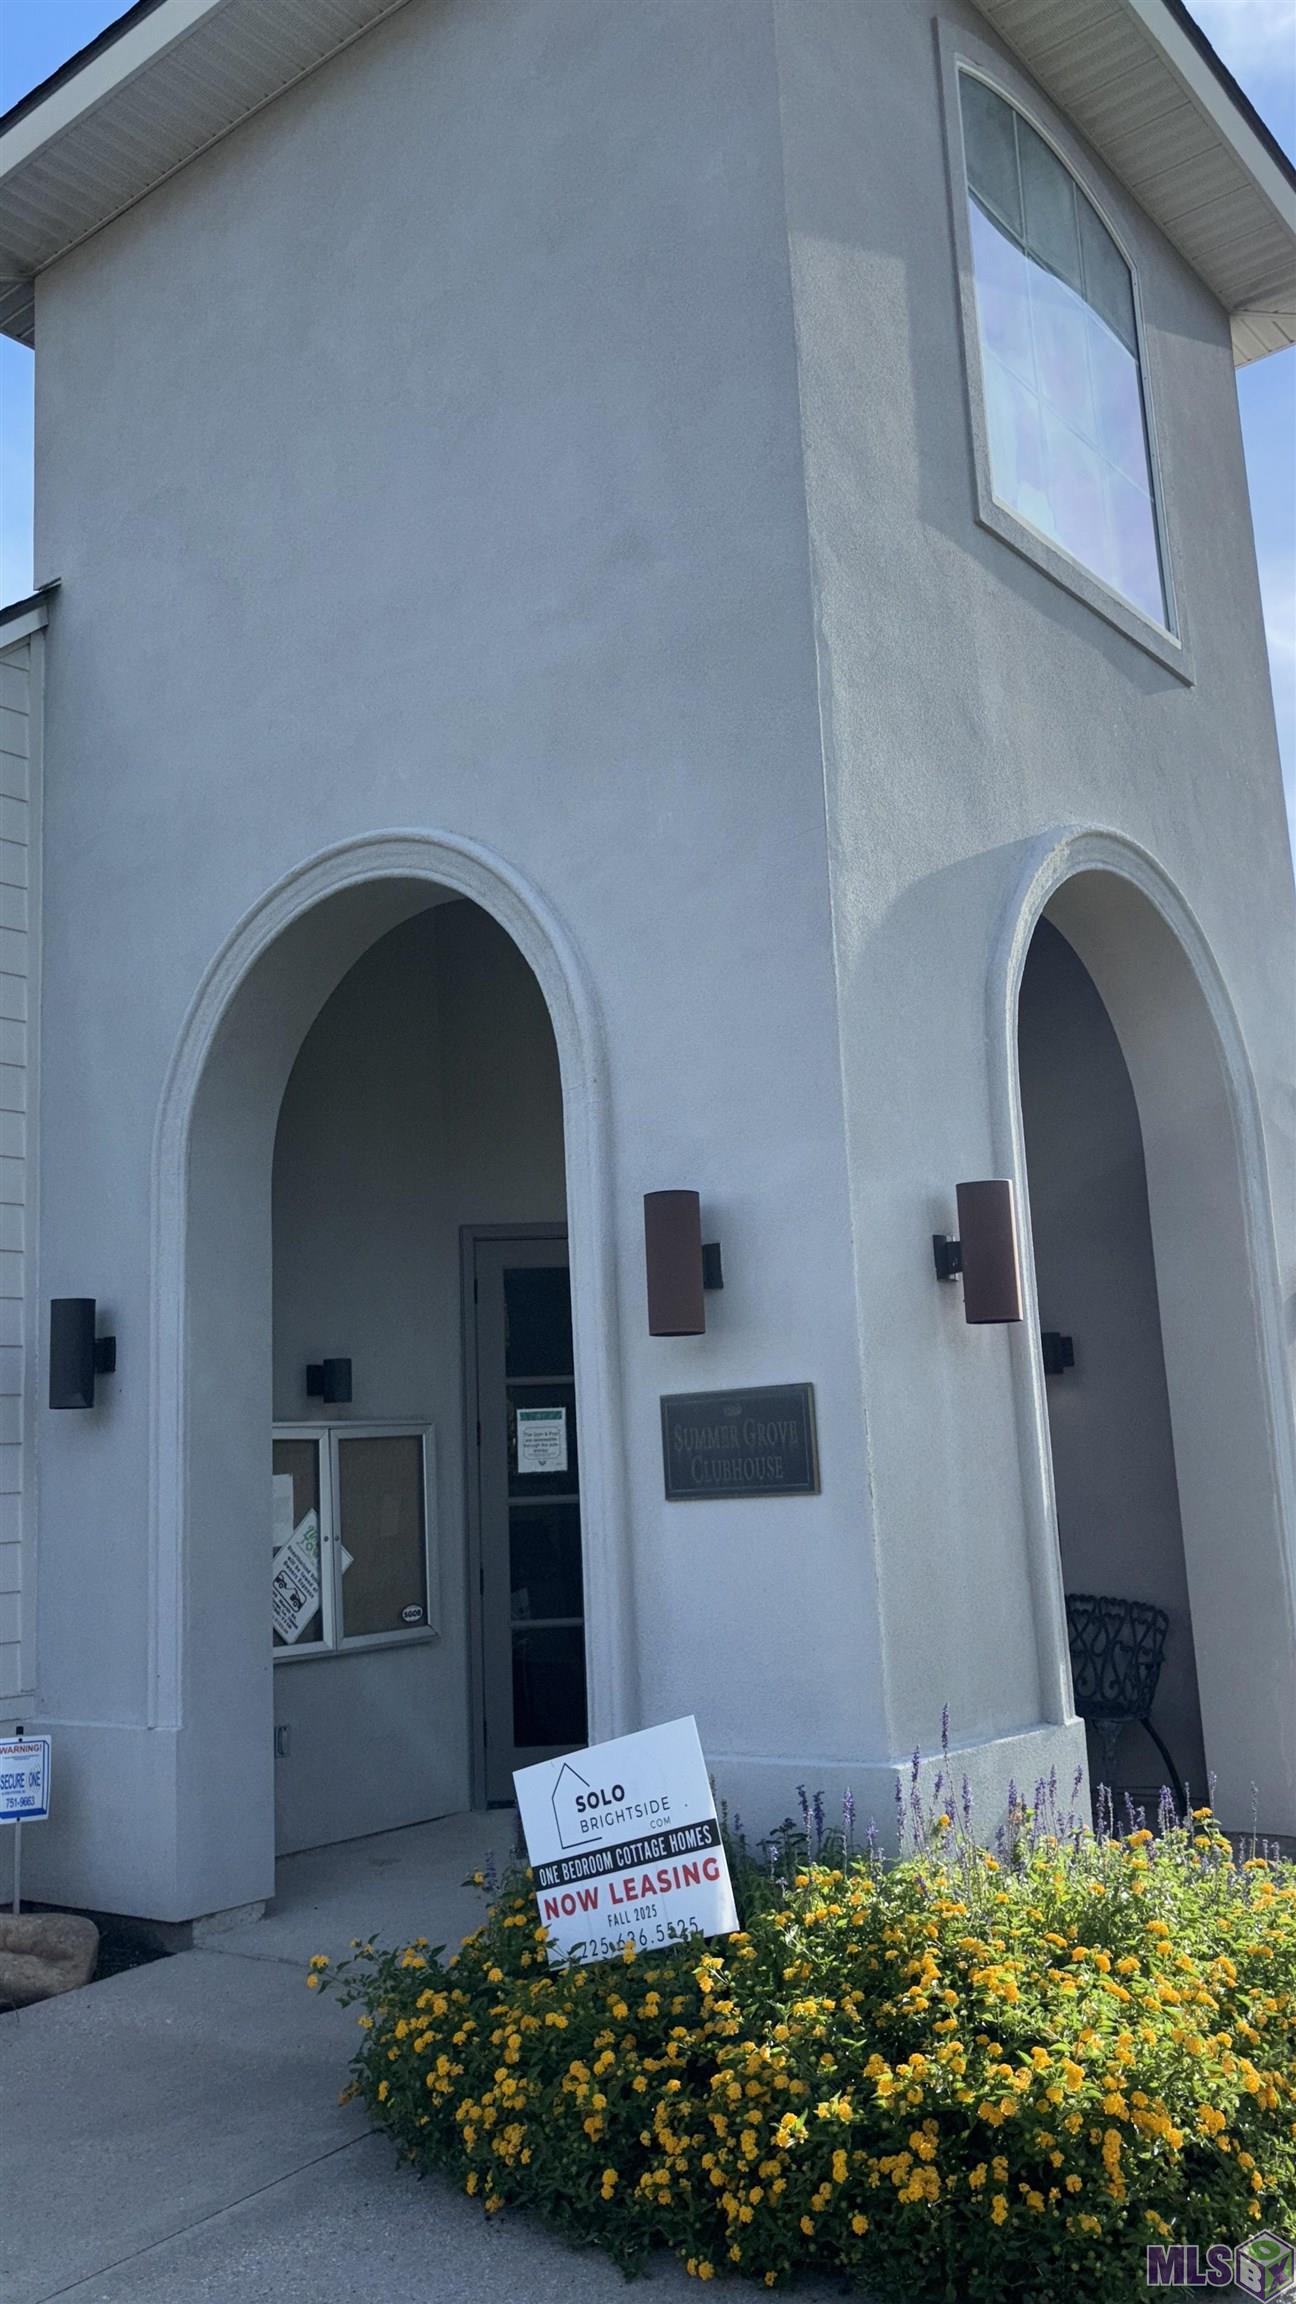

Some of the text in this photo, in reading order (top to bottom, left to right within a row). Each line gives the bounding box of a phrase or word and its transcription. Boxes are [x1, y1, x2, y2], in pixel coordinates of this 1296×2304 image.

[674, 1417, 800, 1451] SUMMER GROVE
[691, 1454, 784, 1483] CLUBHOUSE
[0, 1743, 42, 1754] WARNING!
[0, 1771, 41, 1790] SECURE ONE
[575, 1784, 625, 1813] SOLO
[579, 1796, 671, 1833] BRIGHTSIDE
[649, 1816, 671, 1830] COM
[539, 1825, 713, 1887] ONE BEDROOM COTTAGE HOMES
[543, 1857, 721, 1921] NOW LEASING
[607, 1904, 658, 1928] FALL 2025
[580, 1916, 700, 1960] 225636.5525
